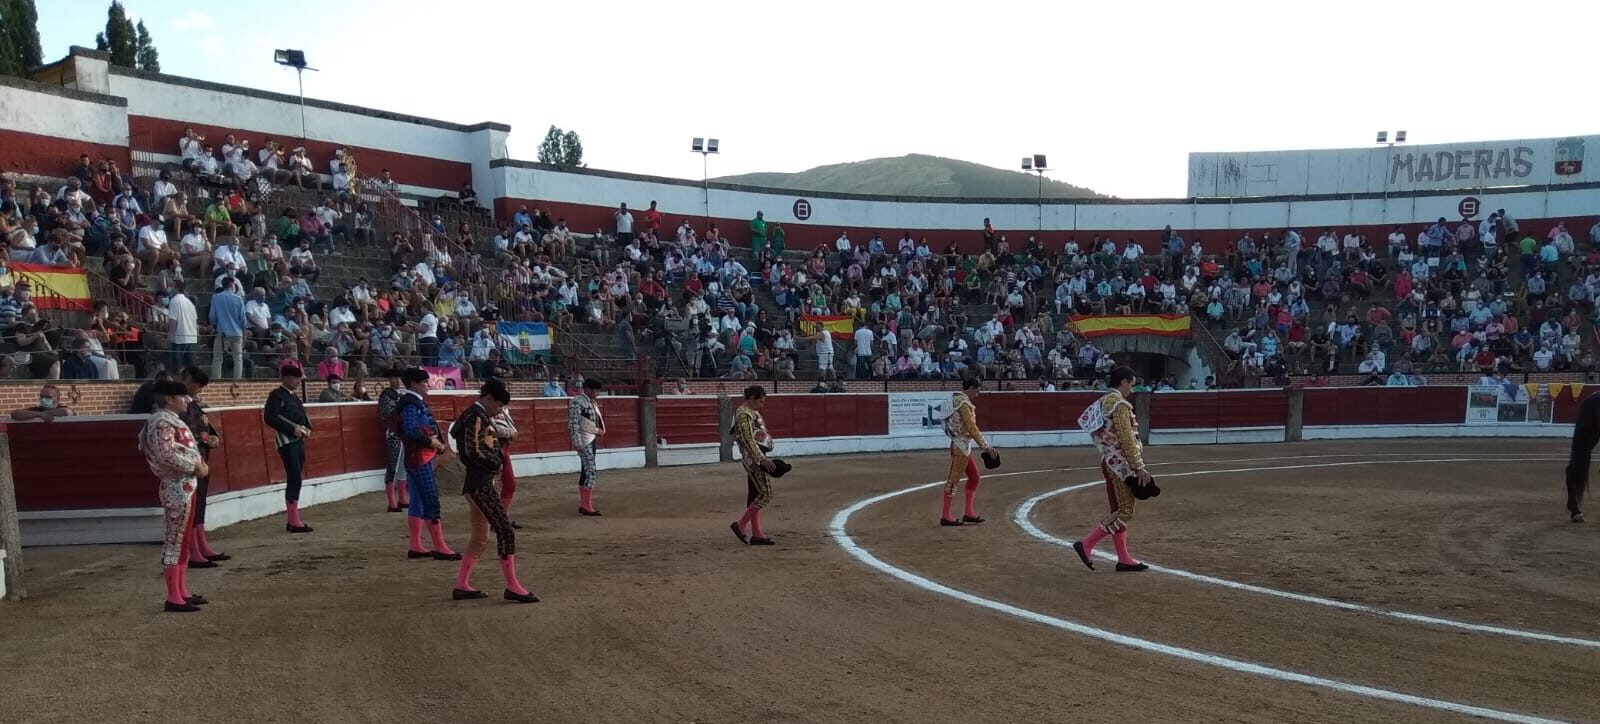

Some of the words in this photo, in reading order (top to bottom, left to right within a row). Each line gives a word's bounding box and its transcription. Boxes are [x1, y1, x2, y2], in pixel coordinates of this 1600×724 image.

[1390, 146, 1534, 184] MADERAS
[797, 202, 809, 217] 8
[1463, 201, 1475, 215] 9
